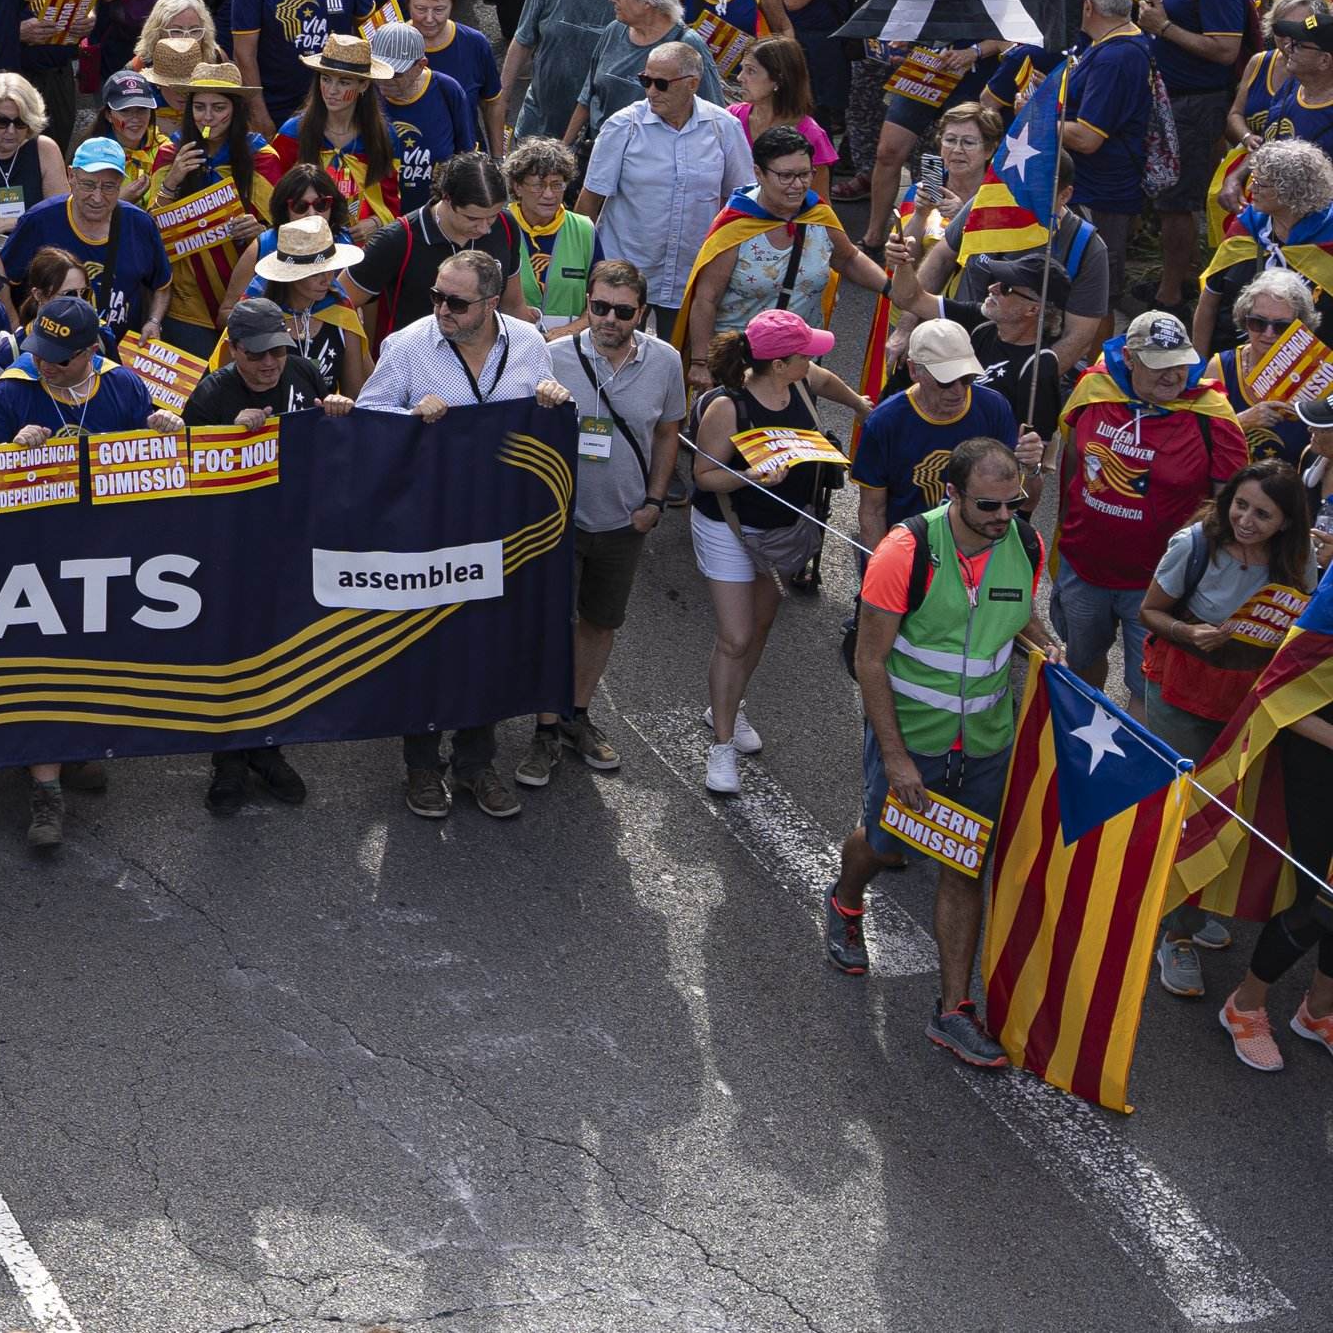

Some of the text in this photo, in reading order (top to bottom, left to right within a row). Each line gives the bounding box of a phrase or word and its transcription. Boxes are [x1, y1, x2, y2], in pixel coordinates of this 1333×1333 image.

[302, 16, 327, 34] VIA
[890, 77, 937, 102] EXIGIM
[403, 147, 430, 165] VIA
[156, 183, 236, 228] INDEPENDÈNCIA
[147, 337, 180, 366] VAM
[1253, 328, 1312, 398] INDEPENDÈNCIA
[132, 355, 179, 387] VOTAR
[1096, 420, 1136, 446] LLUITEM
[98, 435, 178, 465] GOVERN
[193, 439, 276, 473] FOC NOU
[1112, 440, 1155, 462] GUANYEM
[94, 462, 186, 496] DIMISSIÓ
[1086, 490, 1143, 521] INDEPENDÈNCIA
[337, 561, 485, 591] assemblea
[1272, 590, 1312, 613] VAM
[925, 799, 981, 842] VERN
[884, 808, 980, 869] DIMISSIÓ
